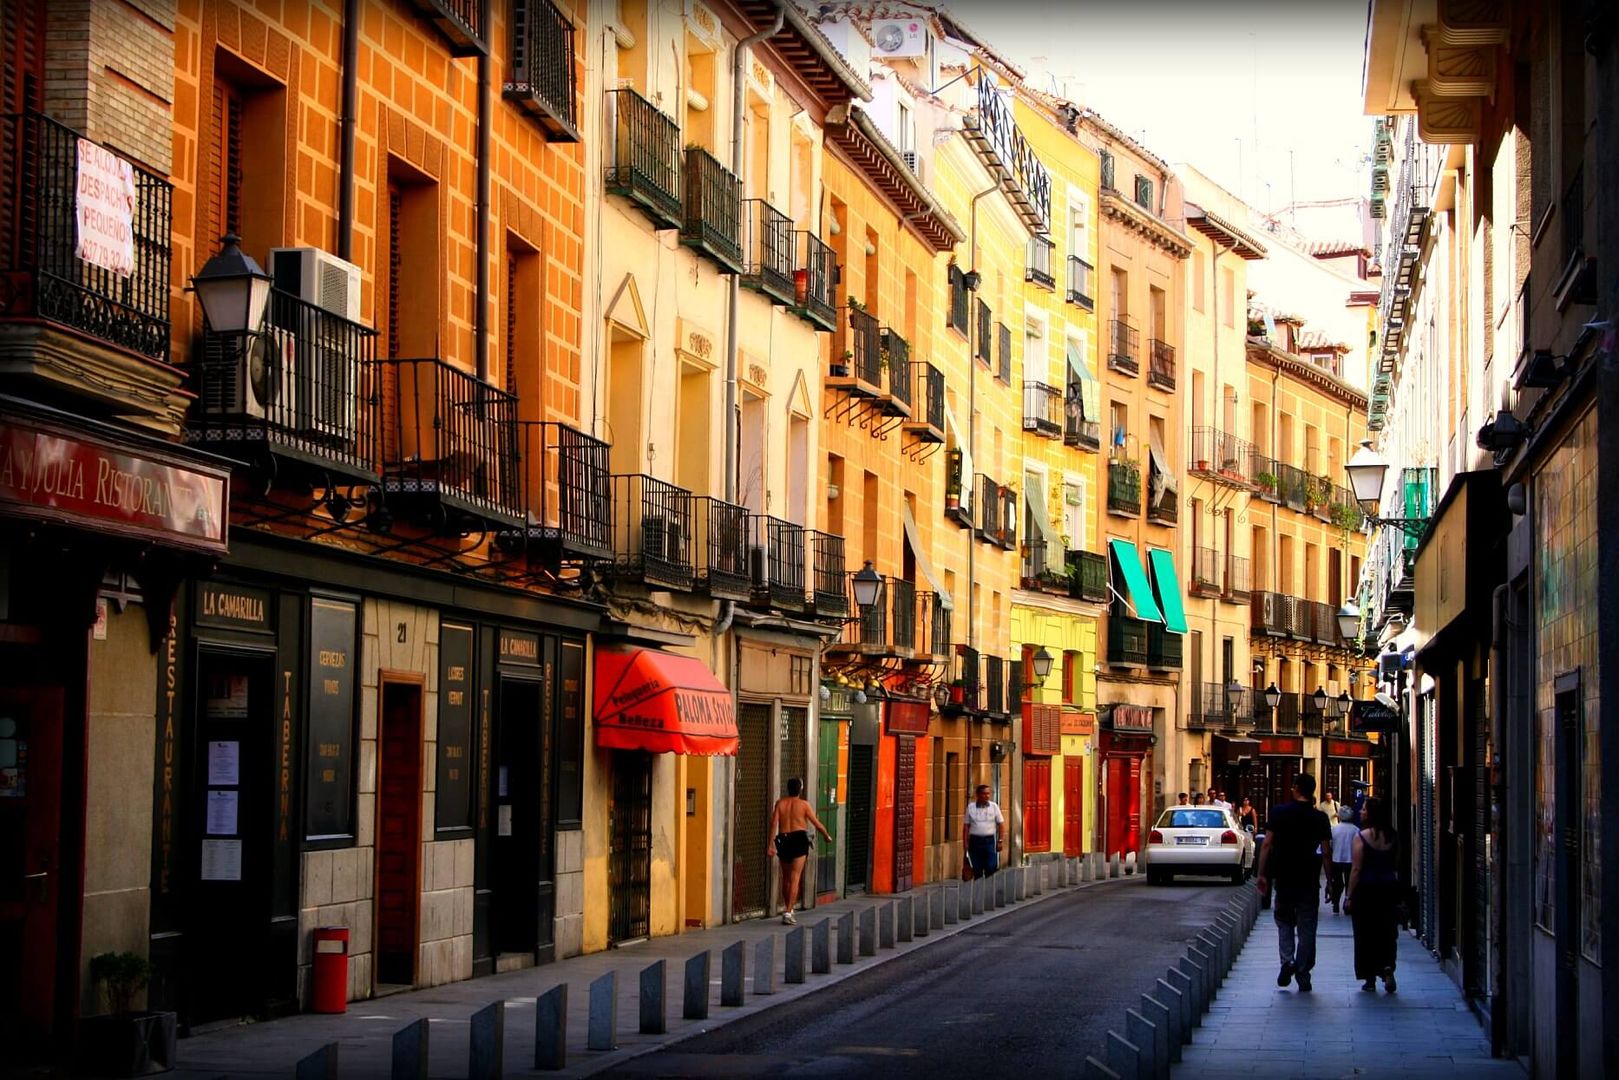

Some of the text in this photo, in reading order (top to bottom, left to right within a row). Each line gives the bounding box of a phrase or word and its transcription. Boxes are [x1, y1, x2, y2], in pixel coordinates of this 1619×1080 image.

[79, 140, 92, 165] SE
[0, 444, 14, 488] A
[33, 455, 85, 500] JULIA
[95, 457, 191, 524] RISTORAN
[203, 592, 264, 622] LA CAMARILLA
[397, 622, 407, 643] 21
[674, 693, 713, 724] PALOMA
[280, 671, 292, 841] TABERNA
